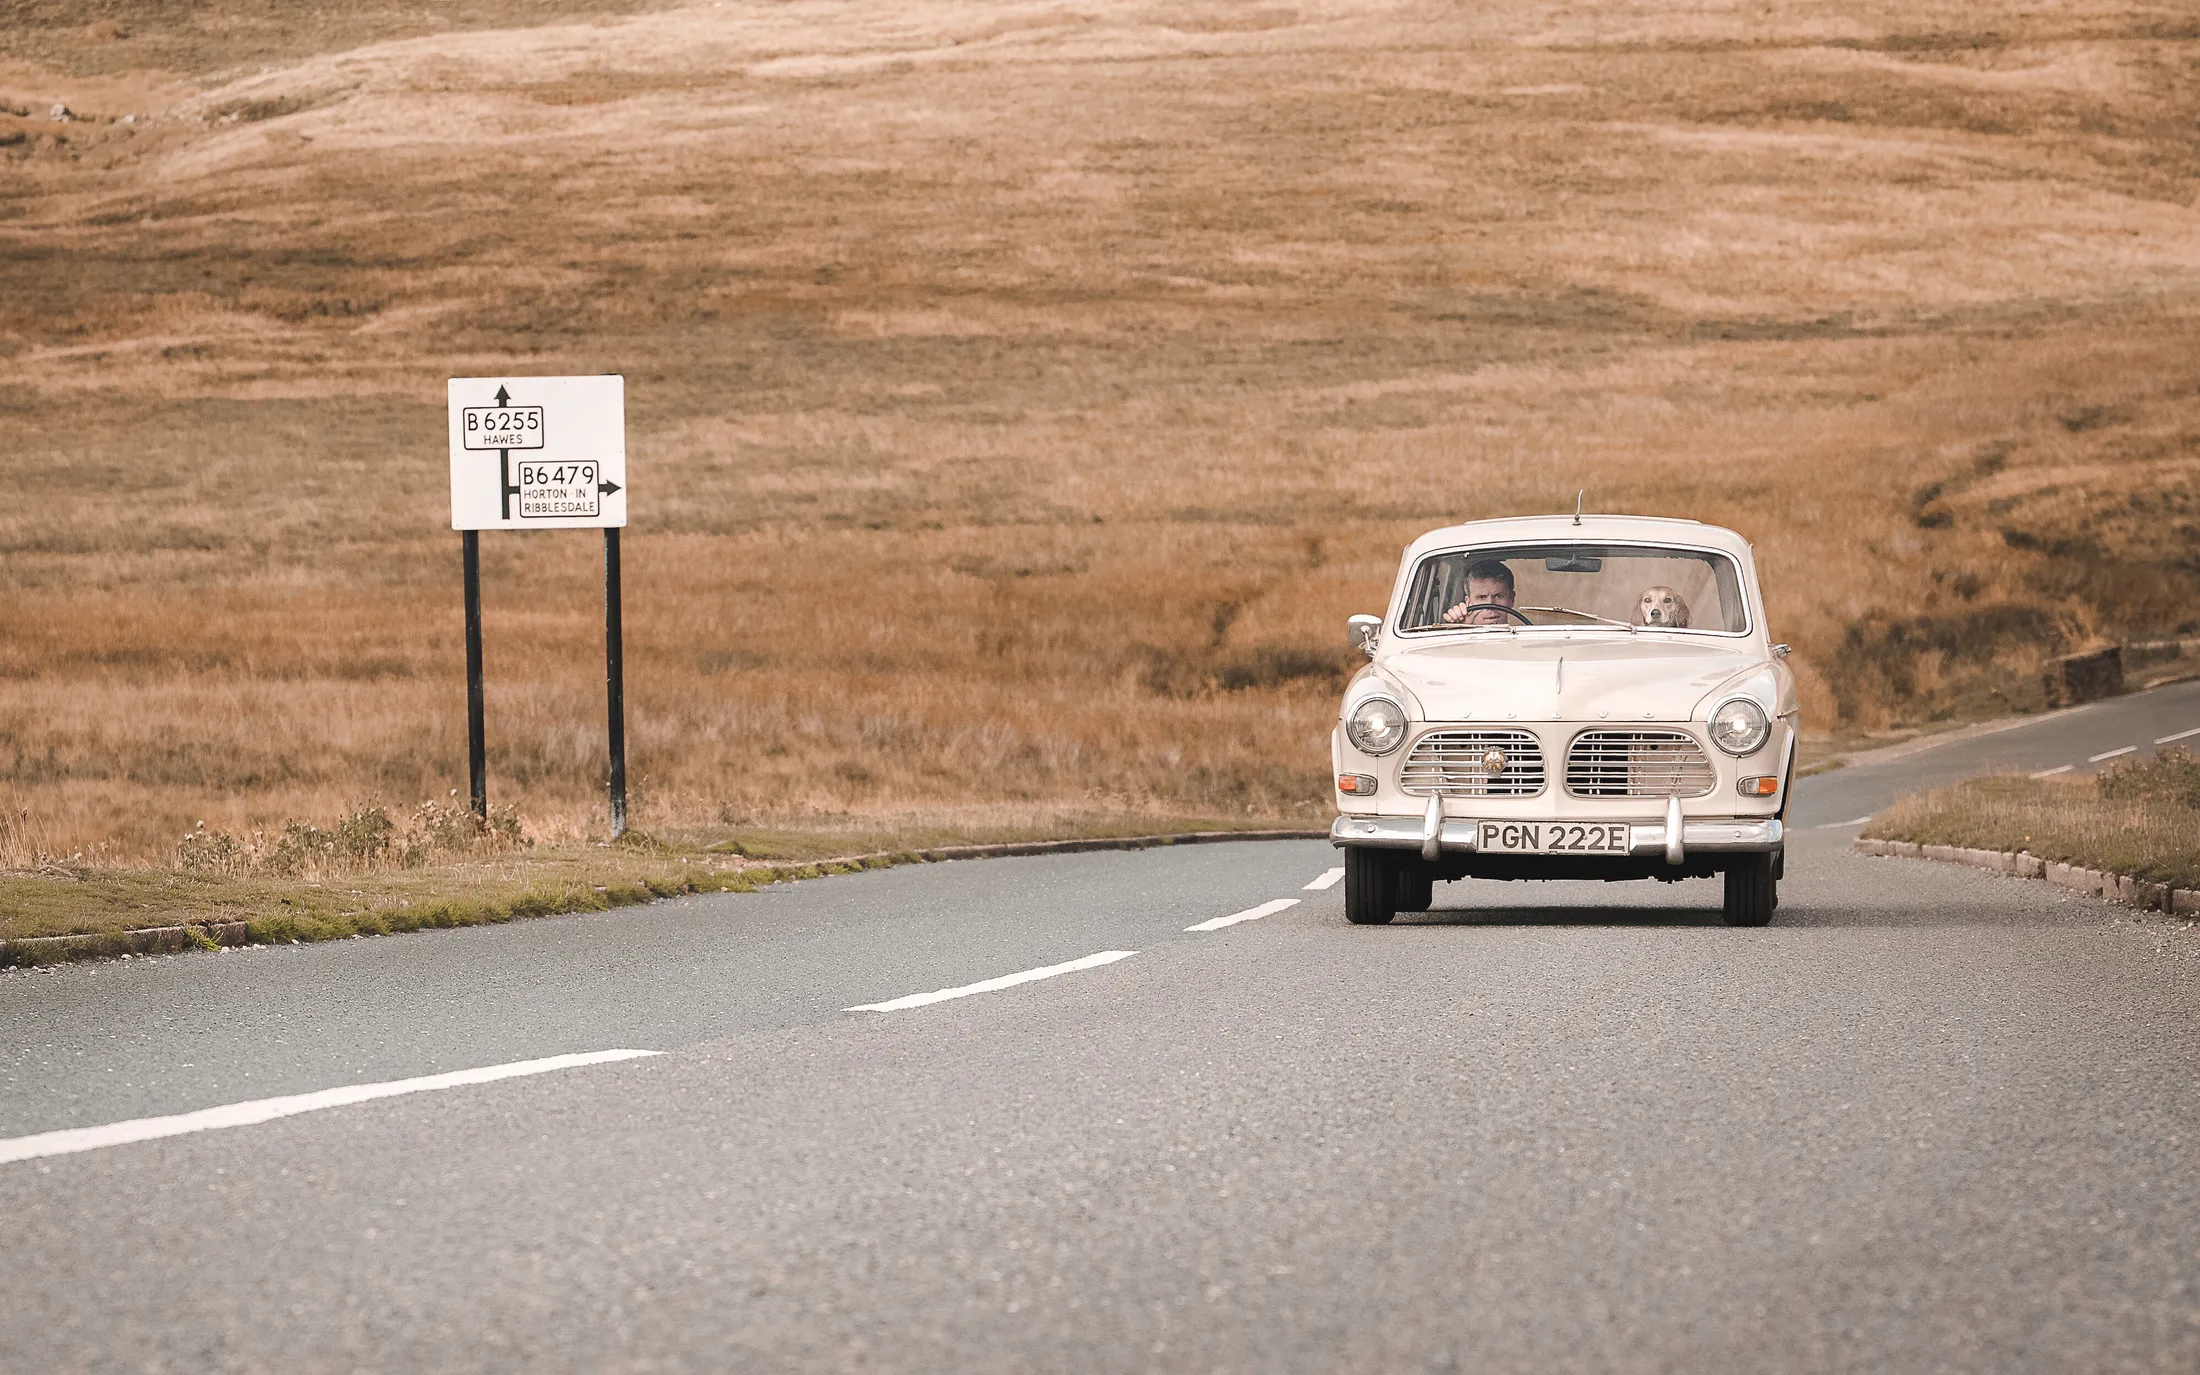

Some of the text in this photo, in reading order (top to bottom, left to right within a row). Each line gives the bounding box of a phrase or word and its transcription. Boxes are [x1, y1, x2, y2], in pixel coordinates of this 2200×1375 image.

[483, 434, 523, 445] HAWES
[523, 466, 594, 485] B6479
[524, 502, 595, 513] RIBBLESDALE
[1482, 824, 1625, 851] PGN 222E
